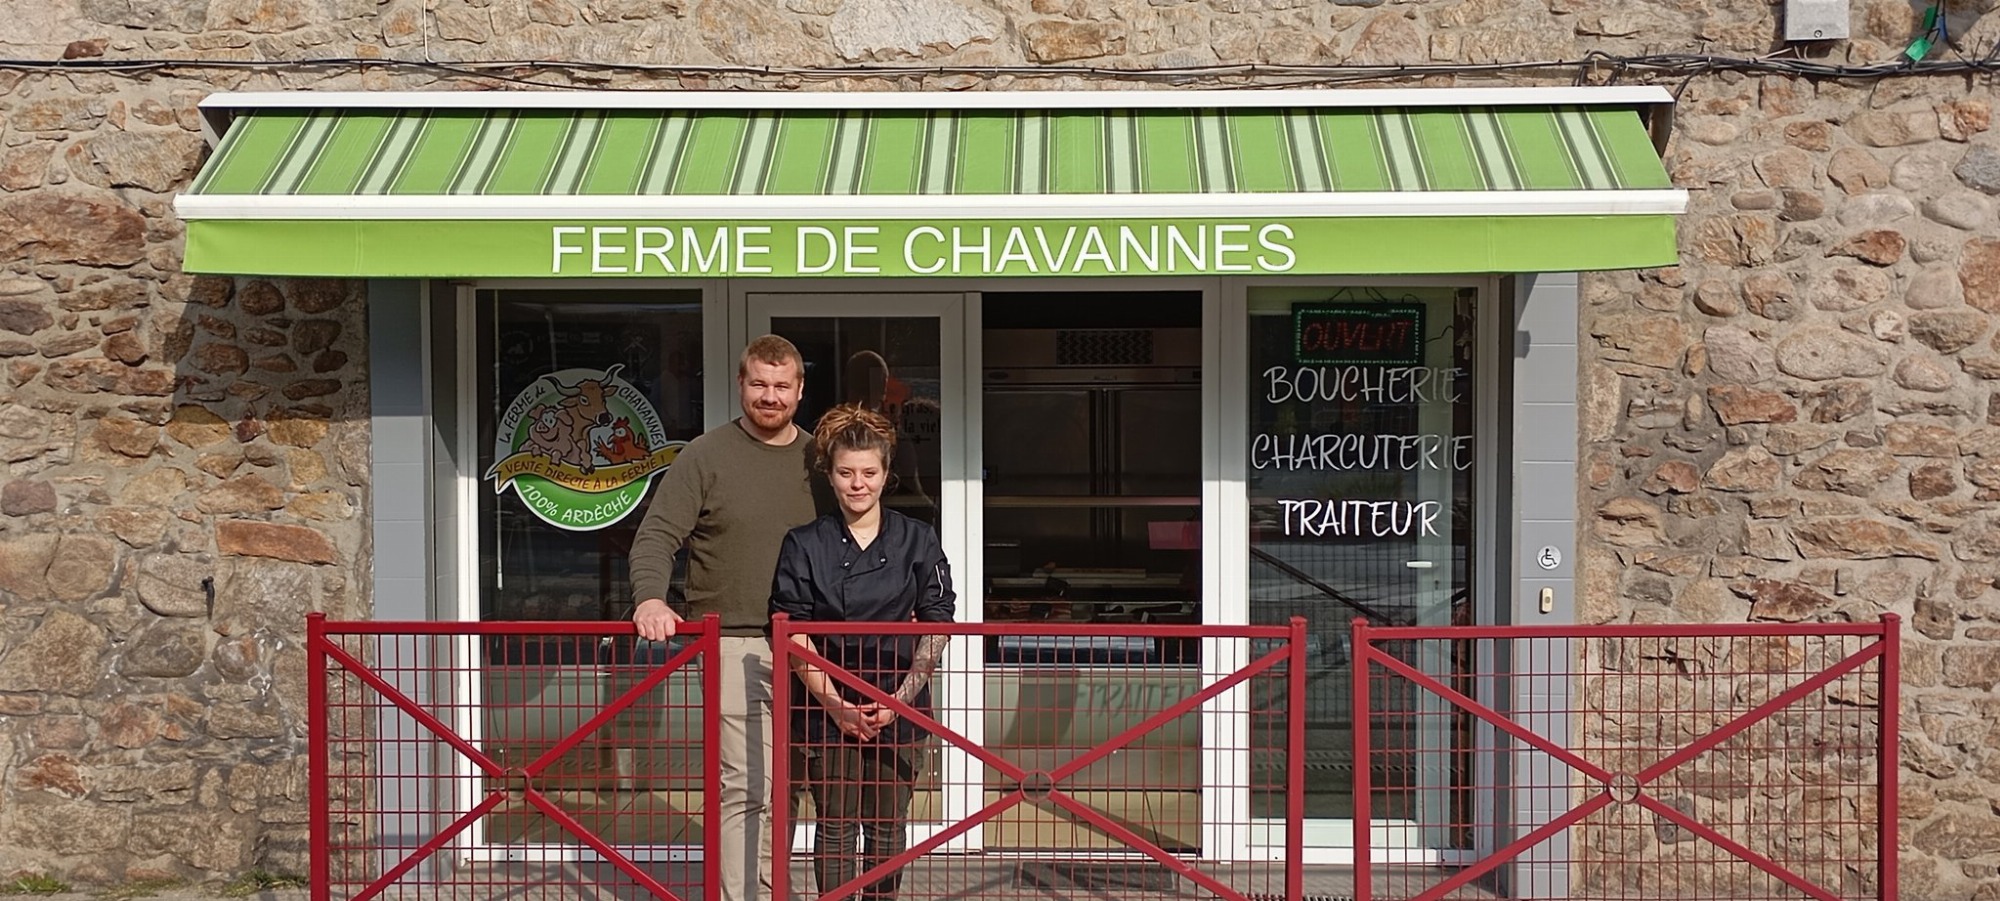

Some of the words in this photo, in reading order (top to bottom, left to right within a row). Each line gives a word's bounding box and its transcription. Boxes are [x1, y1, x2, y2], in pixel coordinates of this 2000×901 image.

[551, 226, 774, 274] FERME
[796, 226, 881, 274] DE
[902, 223, 1297, 274] CHAVANNES
[1262, 365, 1463, 404] BOUCHERIE
[504, 391, 534, 430] FERME
[535, 385, 546, 399] de
[618, 386, 665, 446] CHAVANNES
[1251, 433, 1473, 471] CHARCUTERIE
[505, 461, 543, 474] VENTE
[544, 467, 590, 490] DIRECTE
[605, 476, 618, 488] LA
[621, 457, 658, 482] FERME
[522, 484, 559, 517] 100%
[561, 490, 632, 524] ARDÈCHE
[1277, 499, 1444, 538] TRAITEUR
